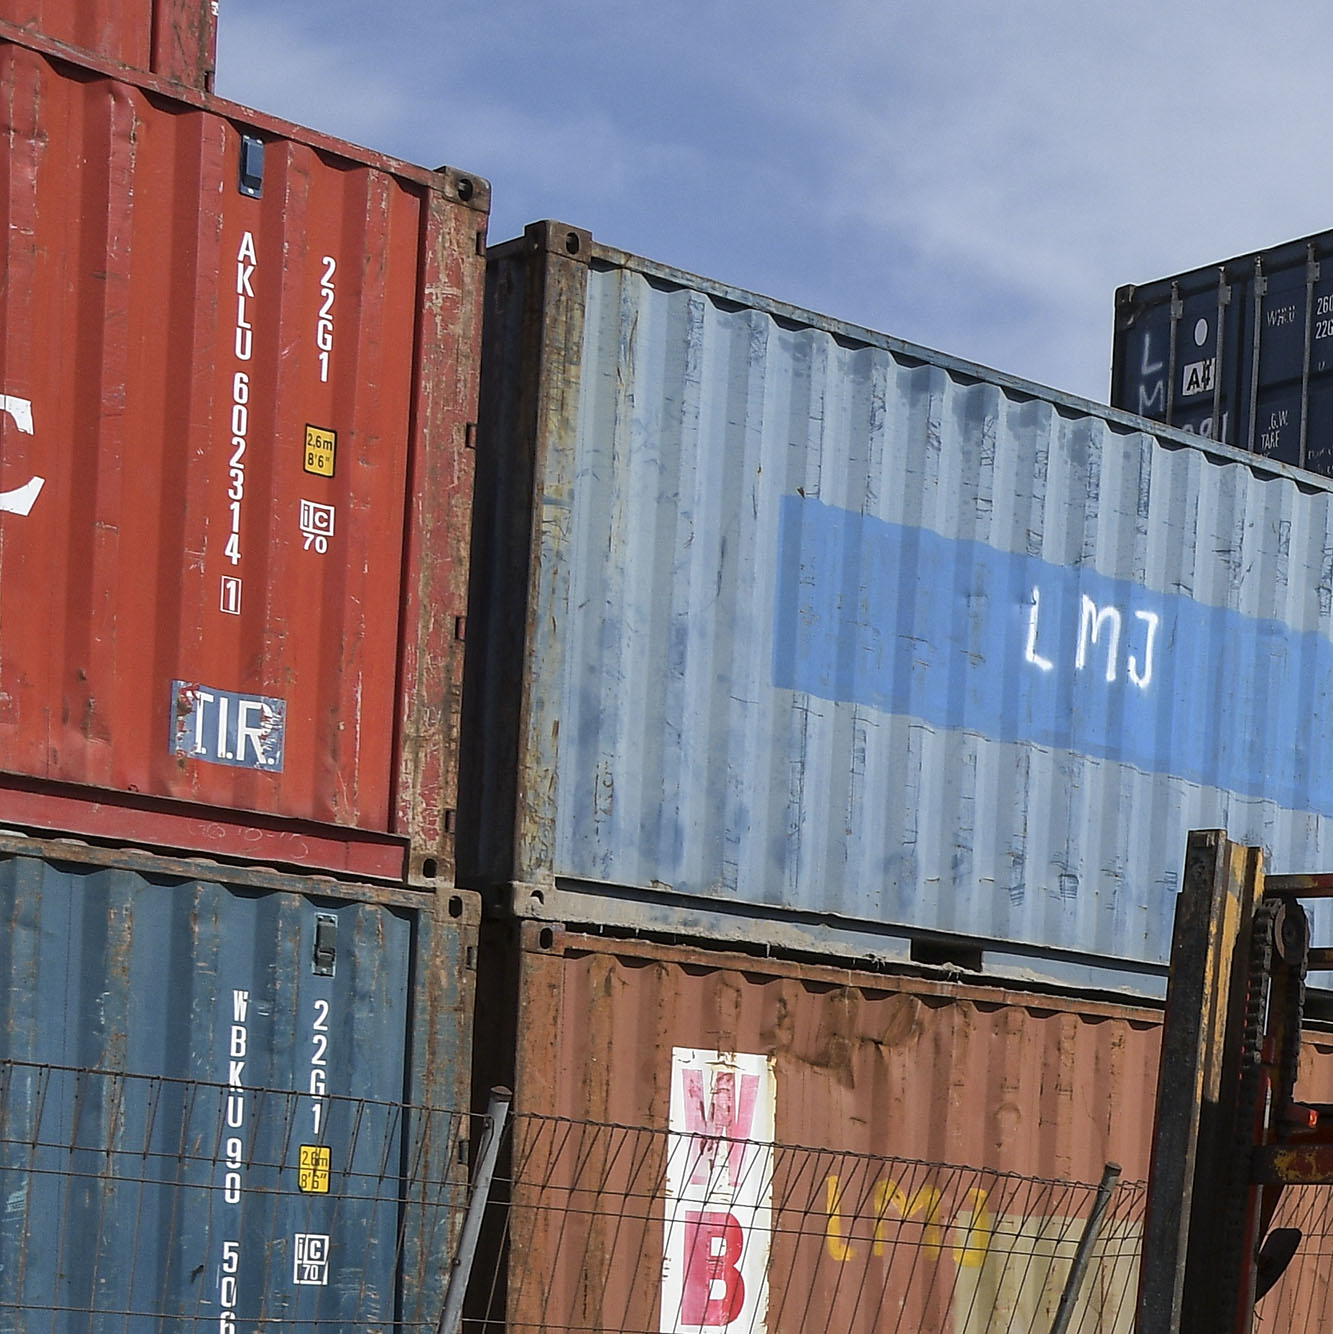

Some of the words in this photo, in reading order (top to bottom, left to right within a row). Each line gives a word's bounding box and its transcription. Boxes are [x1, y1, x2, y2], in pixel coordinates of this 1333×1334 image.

[234, 231, 257, 361] AKLU
[316, 256, 337, 383] 22G1
[224, 372, 249, 566] 602314
[302, 532, 328, 554] 70
[1024, 586, 1159, 690] LMJ
